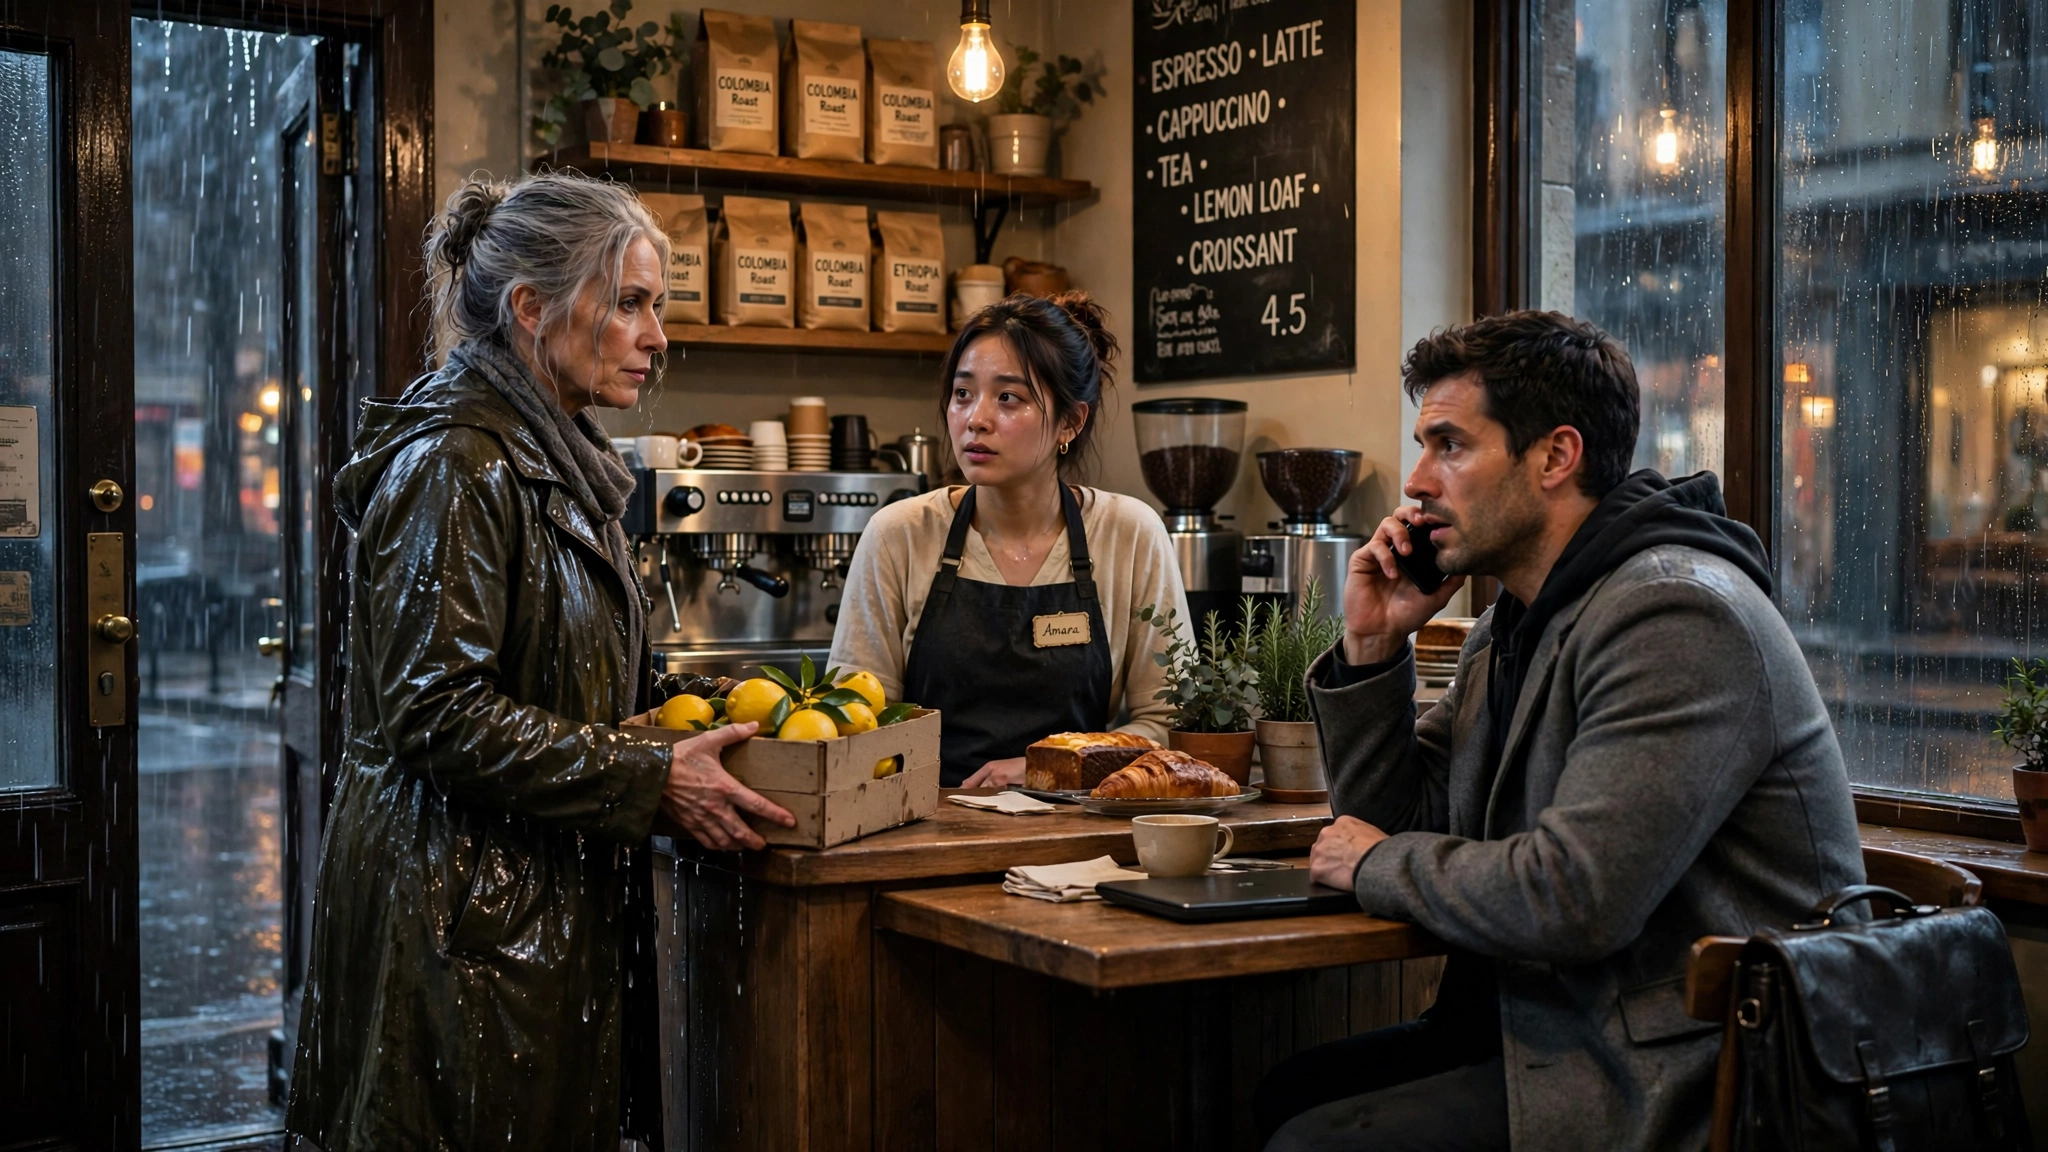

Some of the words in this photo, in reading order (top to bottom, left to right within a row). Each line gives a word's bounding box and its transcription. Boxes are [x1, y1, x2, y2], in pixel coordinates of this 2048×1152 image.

[1152, 41, 1242, 93] ESPRESSO
[1262, 19, 1324, 67] LATTE
[718, 76, 771, 94] COLOMBIA
[807, 83, 858, 101] COLOMBIA
[731, 93, 758, 107] Roast
[820, 100, 846, 113] Roast
[882, 93, 932, 110] COLOMBIA
[894, 110, 920, 123] Roast
[1157, 89, 1270, 143] CAPPUCCINO
[1157, 152, 1193, 187] TEA
[1194, 183, 1253, 224] LEMON
[1260, 173, 1307, 213] LOAF
[1189, 227, 1298, 275] CROISSANT
[670, 252, 702, 267] OMBIA
[738, 256, 788, 271] COLOMBIA
[815, 259, 864, 274] COLOMBIA
[670, 271, 690, 281] oast
[750, 272, 776, 285] Roast
[894, 263, 940, 279] ETHIOPIA
[827, 275, 853, 288] Roast
[905, 280, 929, 293] Roast
[1261, 293, 1307, 337] 4.5
[1042, 622, 1080, 637] Amara
